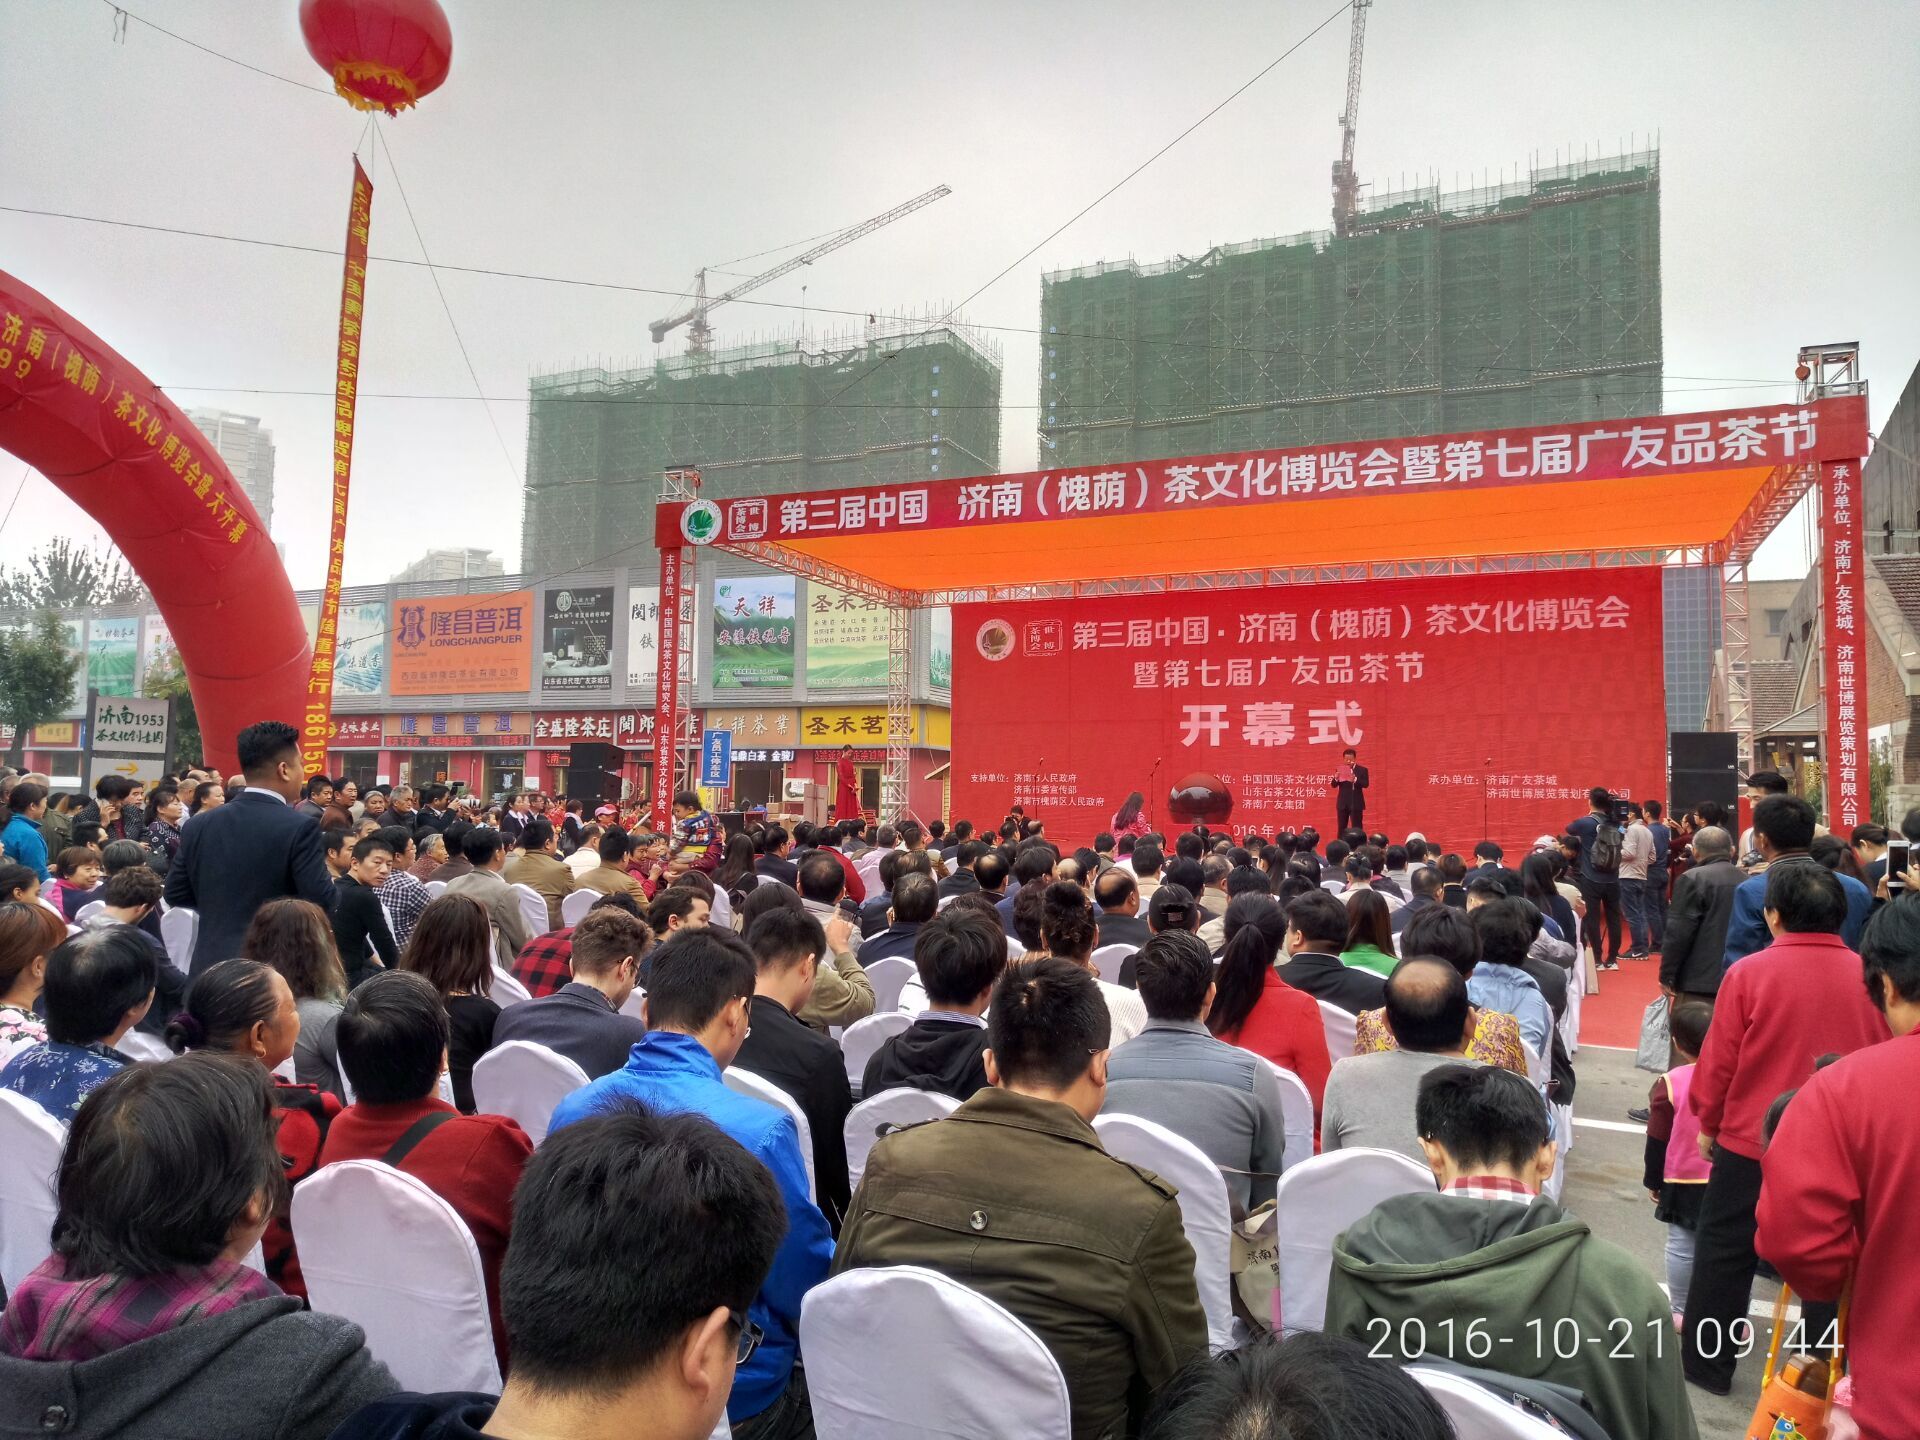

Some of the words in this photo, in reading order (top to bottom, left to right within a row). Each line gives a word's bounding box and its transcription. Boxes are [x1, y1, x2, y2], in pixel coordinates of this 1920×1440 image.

[779, 489, 928, 534] 第三届中国
[430, 606, 523, 637] 隆昌普洱
[429, 635, 522, 648] LONGCHANGPUER
[1132, 651, 1425, 688] 暨第七届广友品茶节
[401, 712, 512, 734] 隆昌普洱
[535, 716, 613, 739] 金盛隆茶庄
[1180, 700, 1364, 748] 开幕式
[1242, 786, 1327, 798] 山东省茶文化协会
[1242, 799, 1306, 810] 济南广友集团
